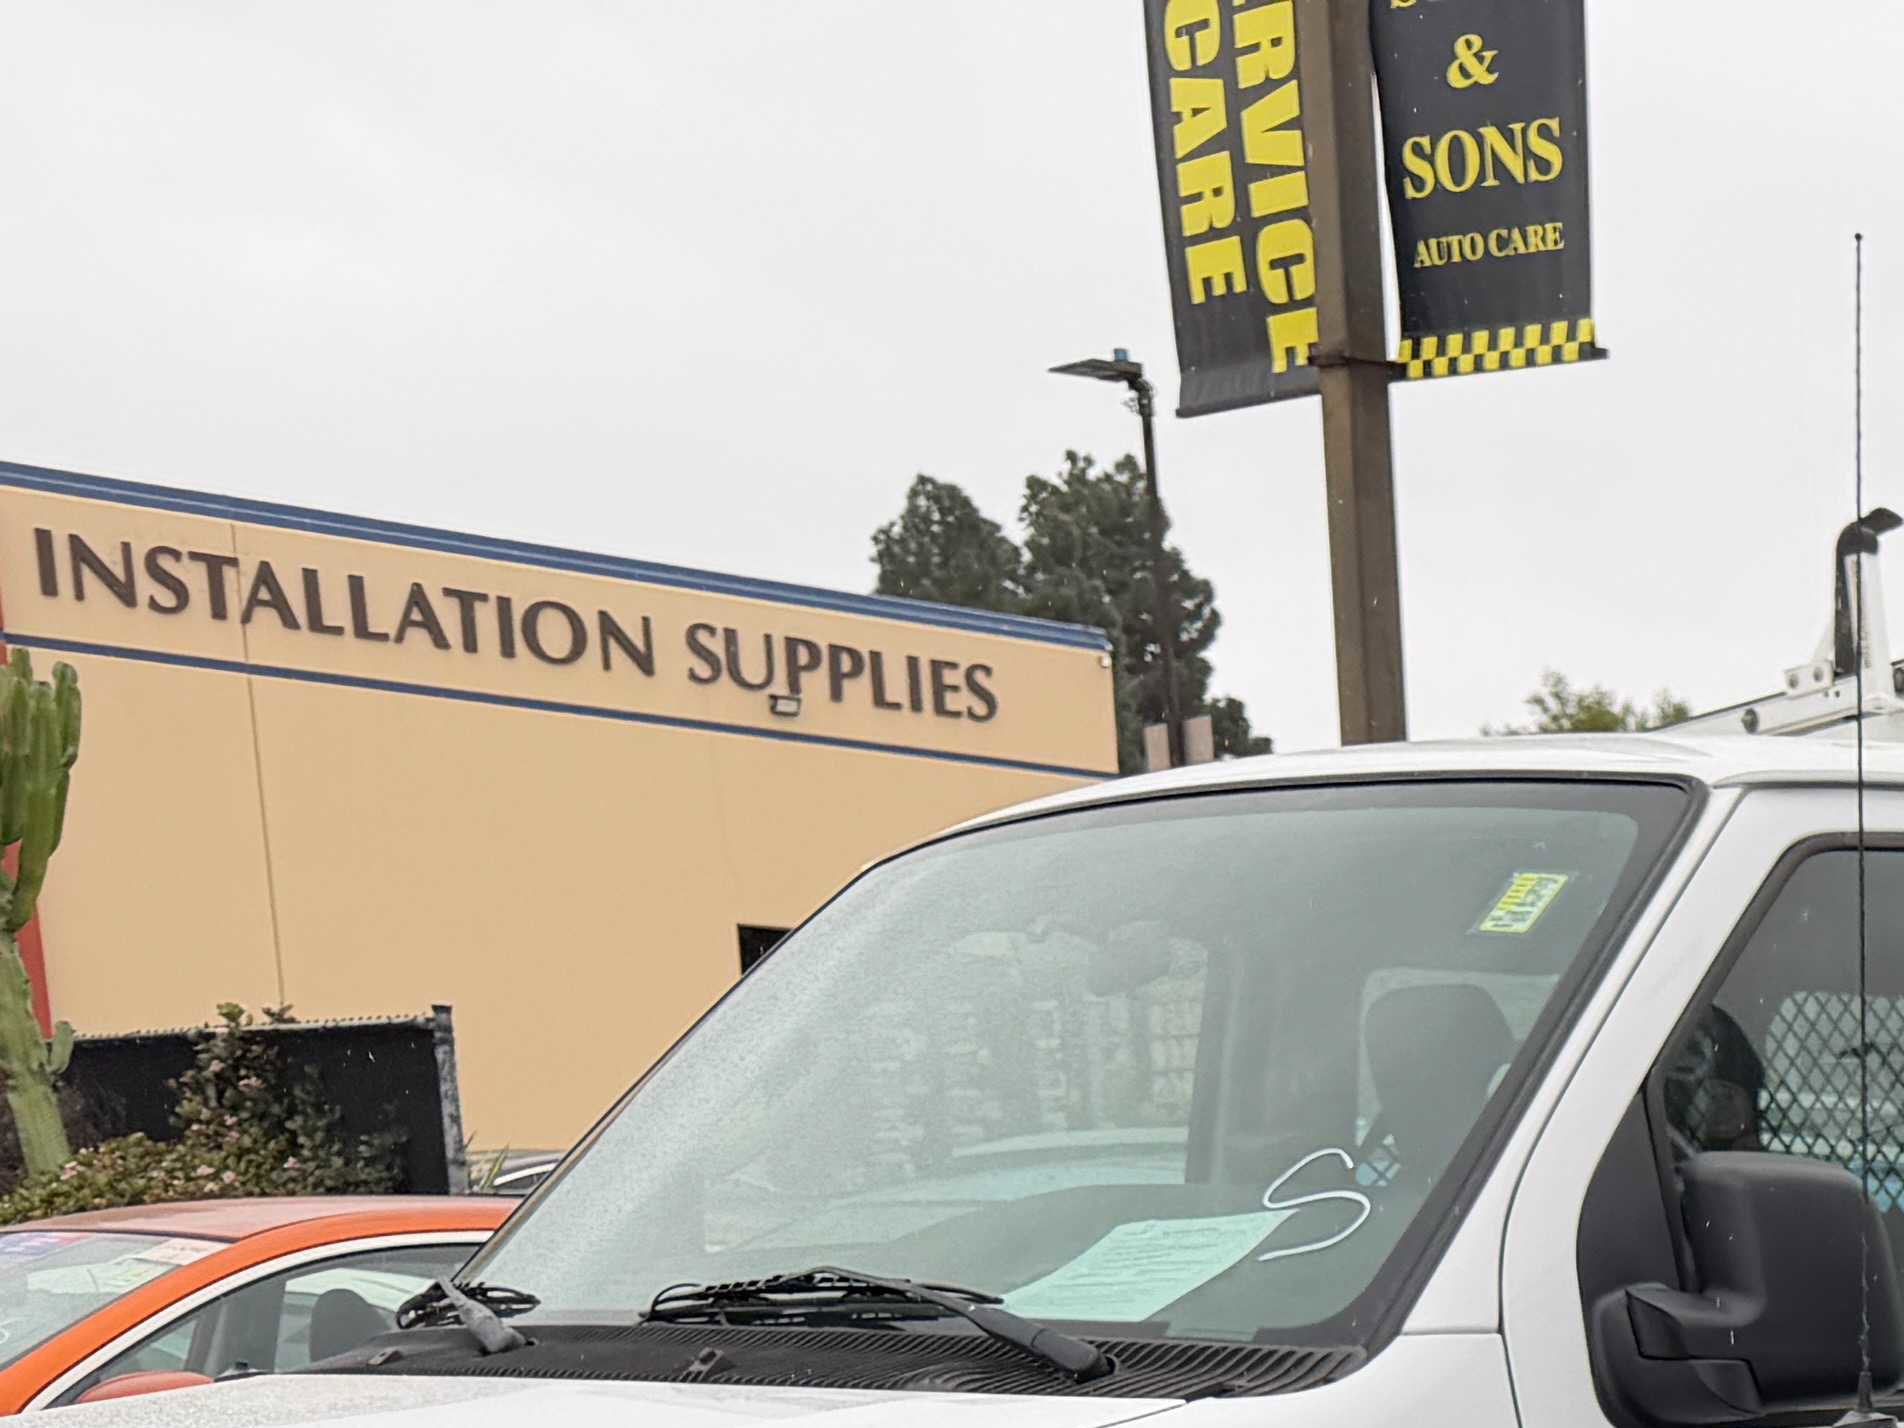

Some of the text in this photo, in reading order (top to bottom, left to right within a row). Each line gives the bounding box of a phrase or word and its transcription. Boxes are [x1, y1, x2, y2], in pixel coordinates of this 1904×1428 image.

[1446, 33, 1500, 89] &
[1163, 0, 1248, 305] CARE
[1232, 0, 1320, 374] RVICE
[1402, 116, 1564, 200] SONS
[1413, 222, 1565, 268] AUTO CARE
[34, 528, 999, 723] INSTALLATION SUPPLIES
